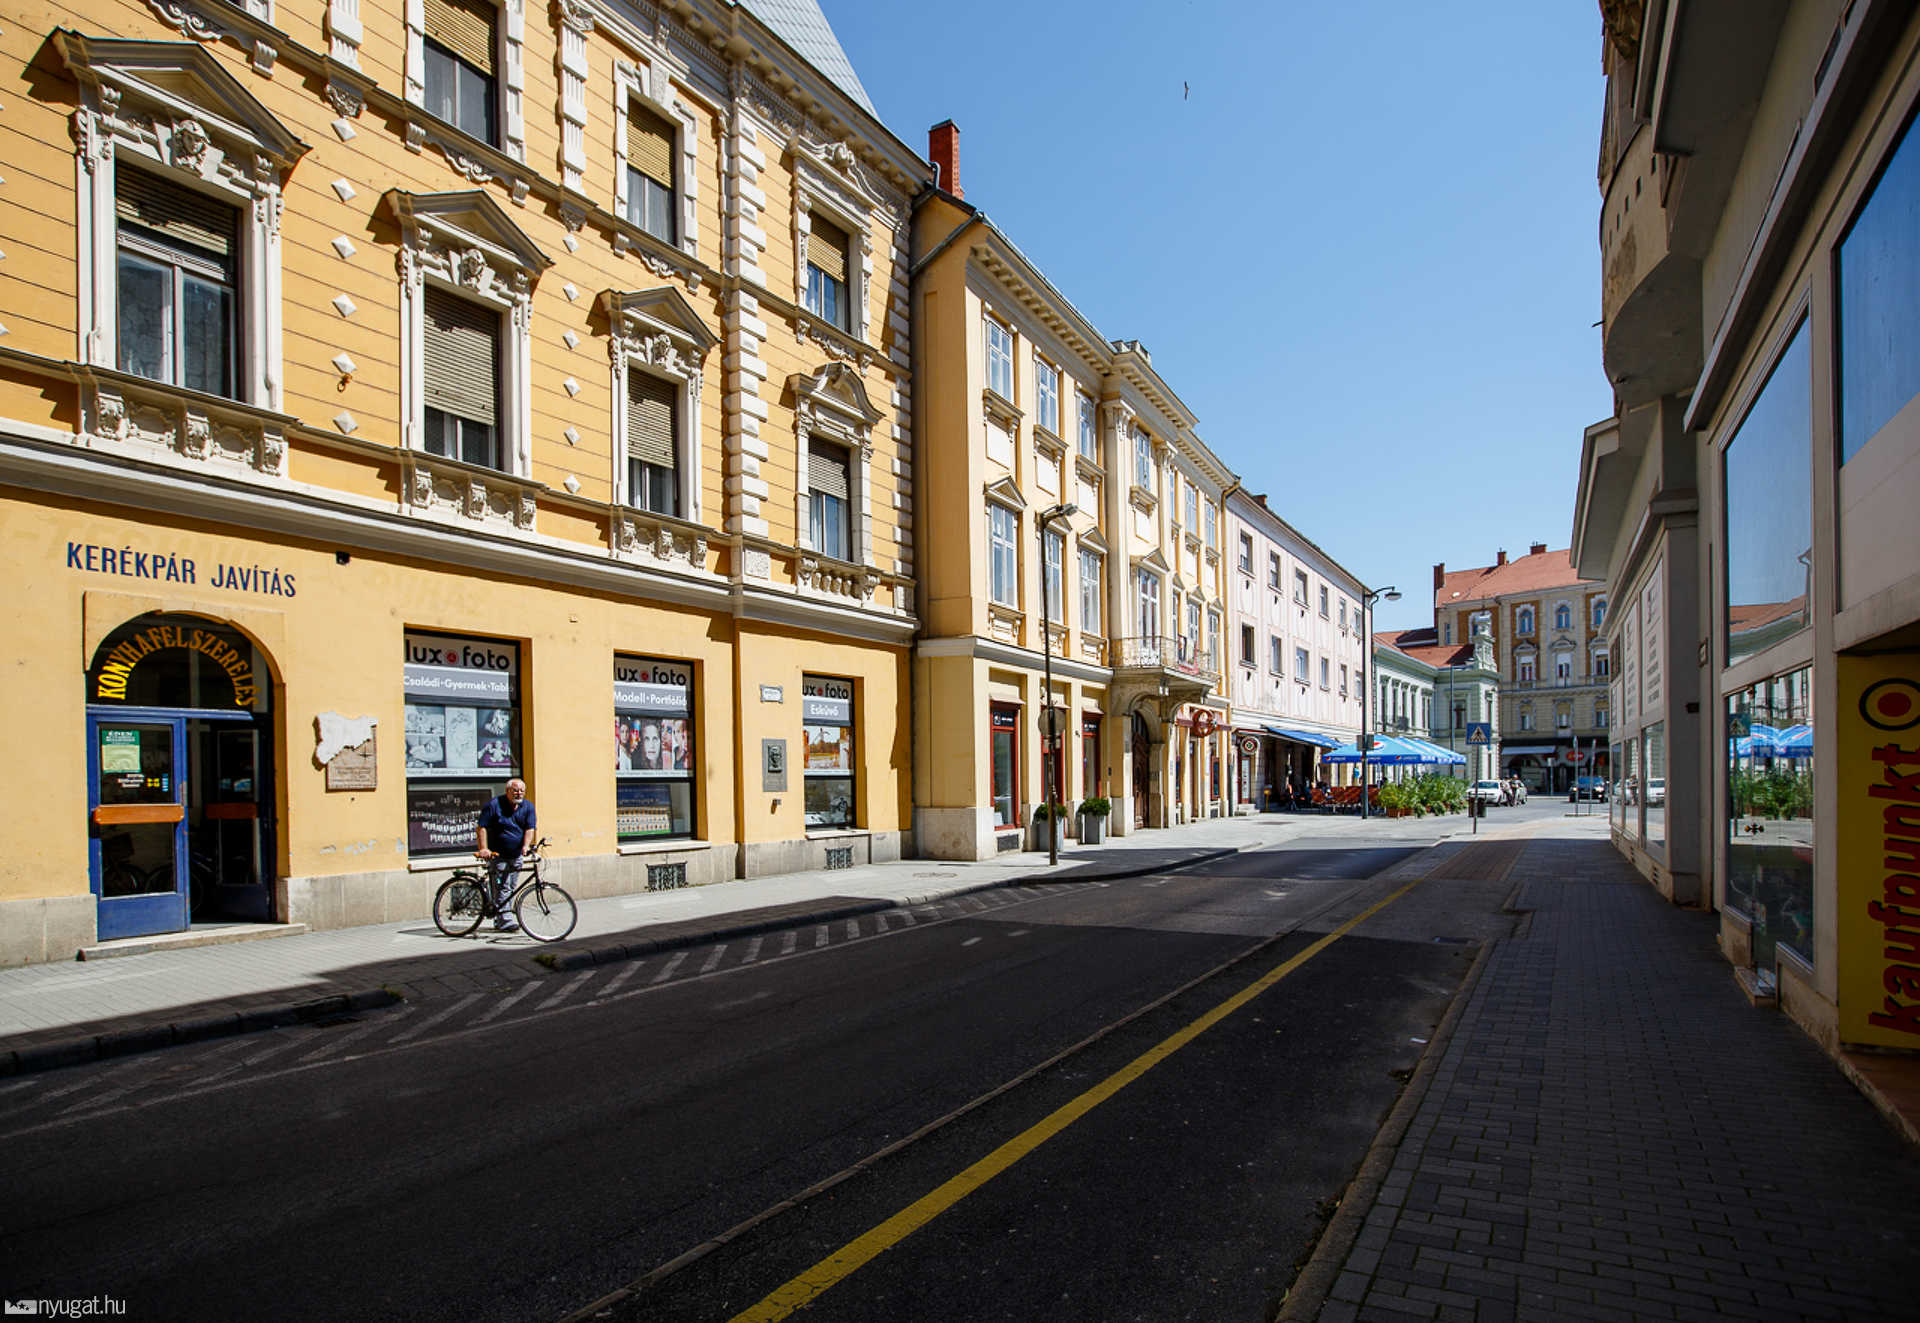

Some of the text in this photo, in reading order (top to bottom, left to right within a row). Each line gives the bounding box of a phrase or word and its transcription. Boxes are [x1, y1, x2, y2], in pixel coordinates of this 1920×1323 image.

[67, 542, 297, 598] KERÉKPÁR JAVÍTÁS
[404, 639, 510, 670] lux foto
[652, 666, 687, 685] foto
[824, 682, 848, 699] foto
